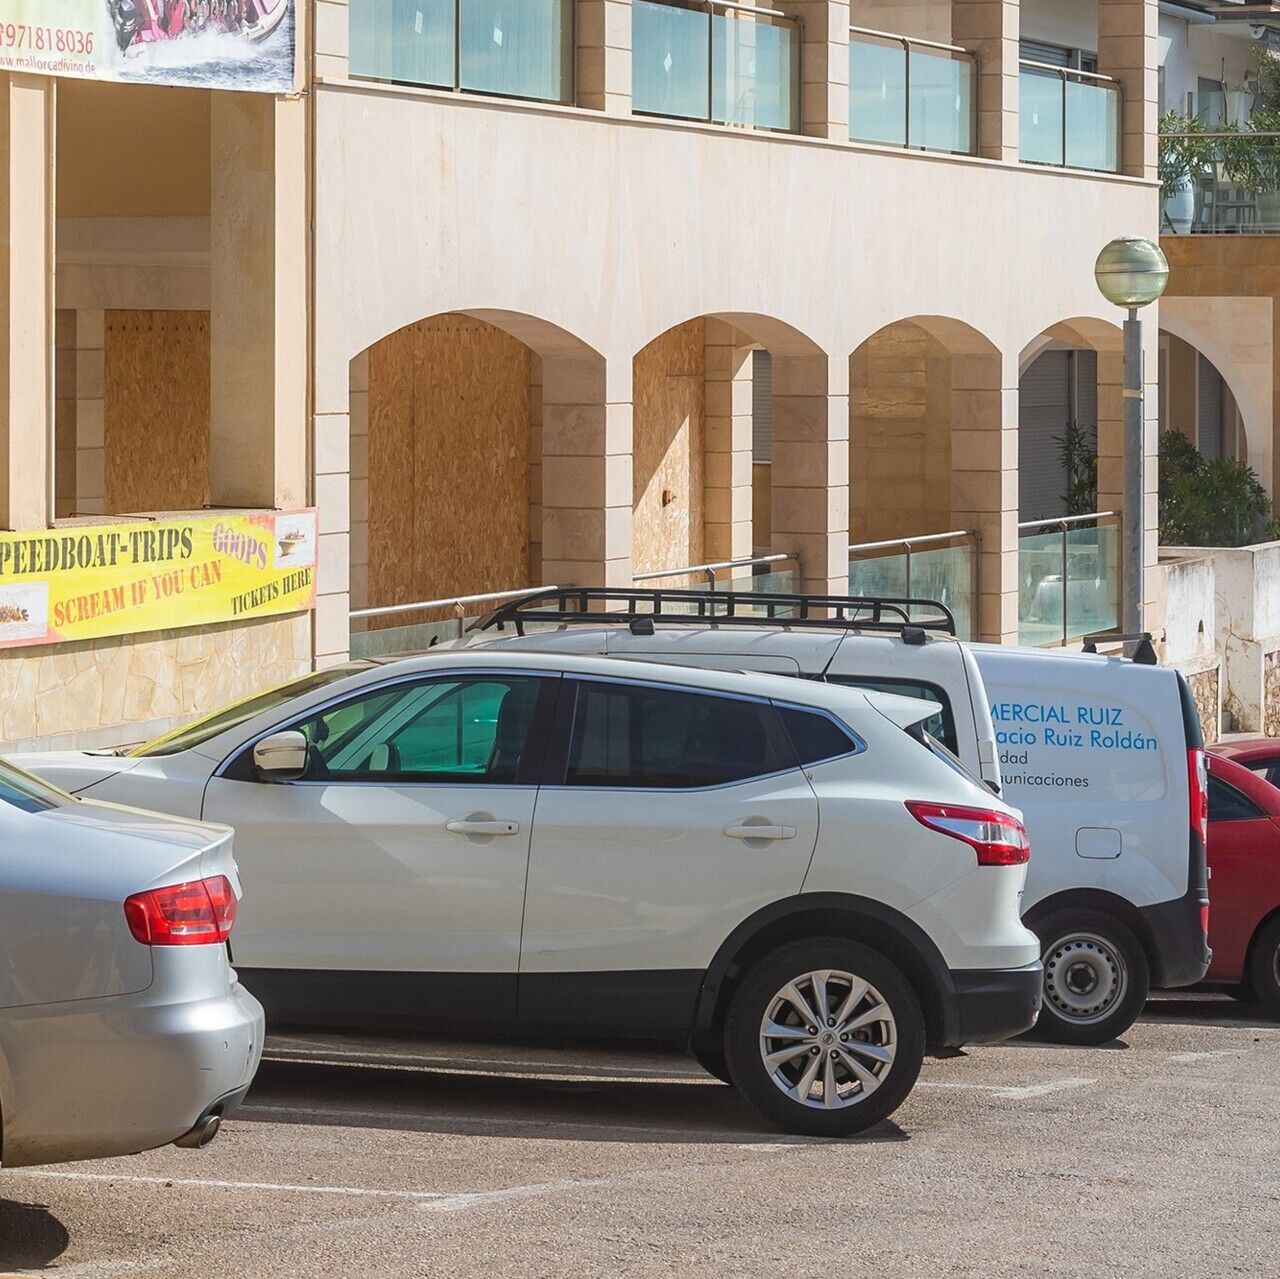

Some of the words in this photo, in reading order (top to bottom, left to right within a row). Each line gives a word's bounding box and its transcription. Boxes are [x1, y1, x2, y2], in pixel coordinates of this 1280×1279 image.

[5, 23, 94, 55] 971818036
[53, 585, 126, 628] SCREAM
[130, 580, 148, 606] IF
[151, 569, 185, 600] YOU
[190, 560, 222, 589] CAN
[231, 581, 279, 615] TICKETS
[282, 567, 312, 595] HERE
[1078, 707, 1123, 726] RUIZ
[994, 727, 1037, 746] acio
[1044, 728, 1083, 747] Ruiz
[1090, 730, 1157, 750] Roldán
[1000, 750, 1028, 765] dad
